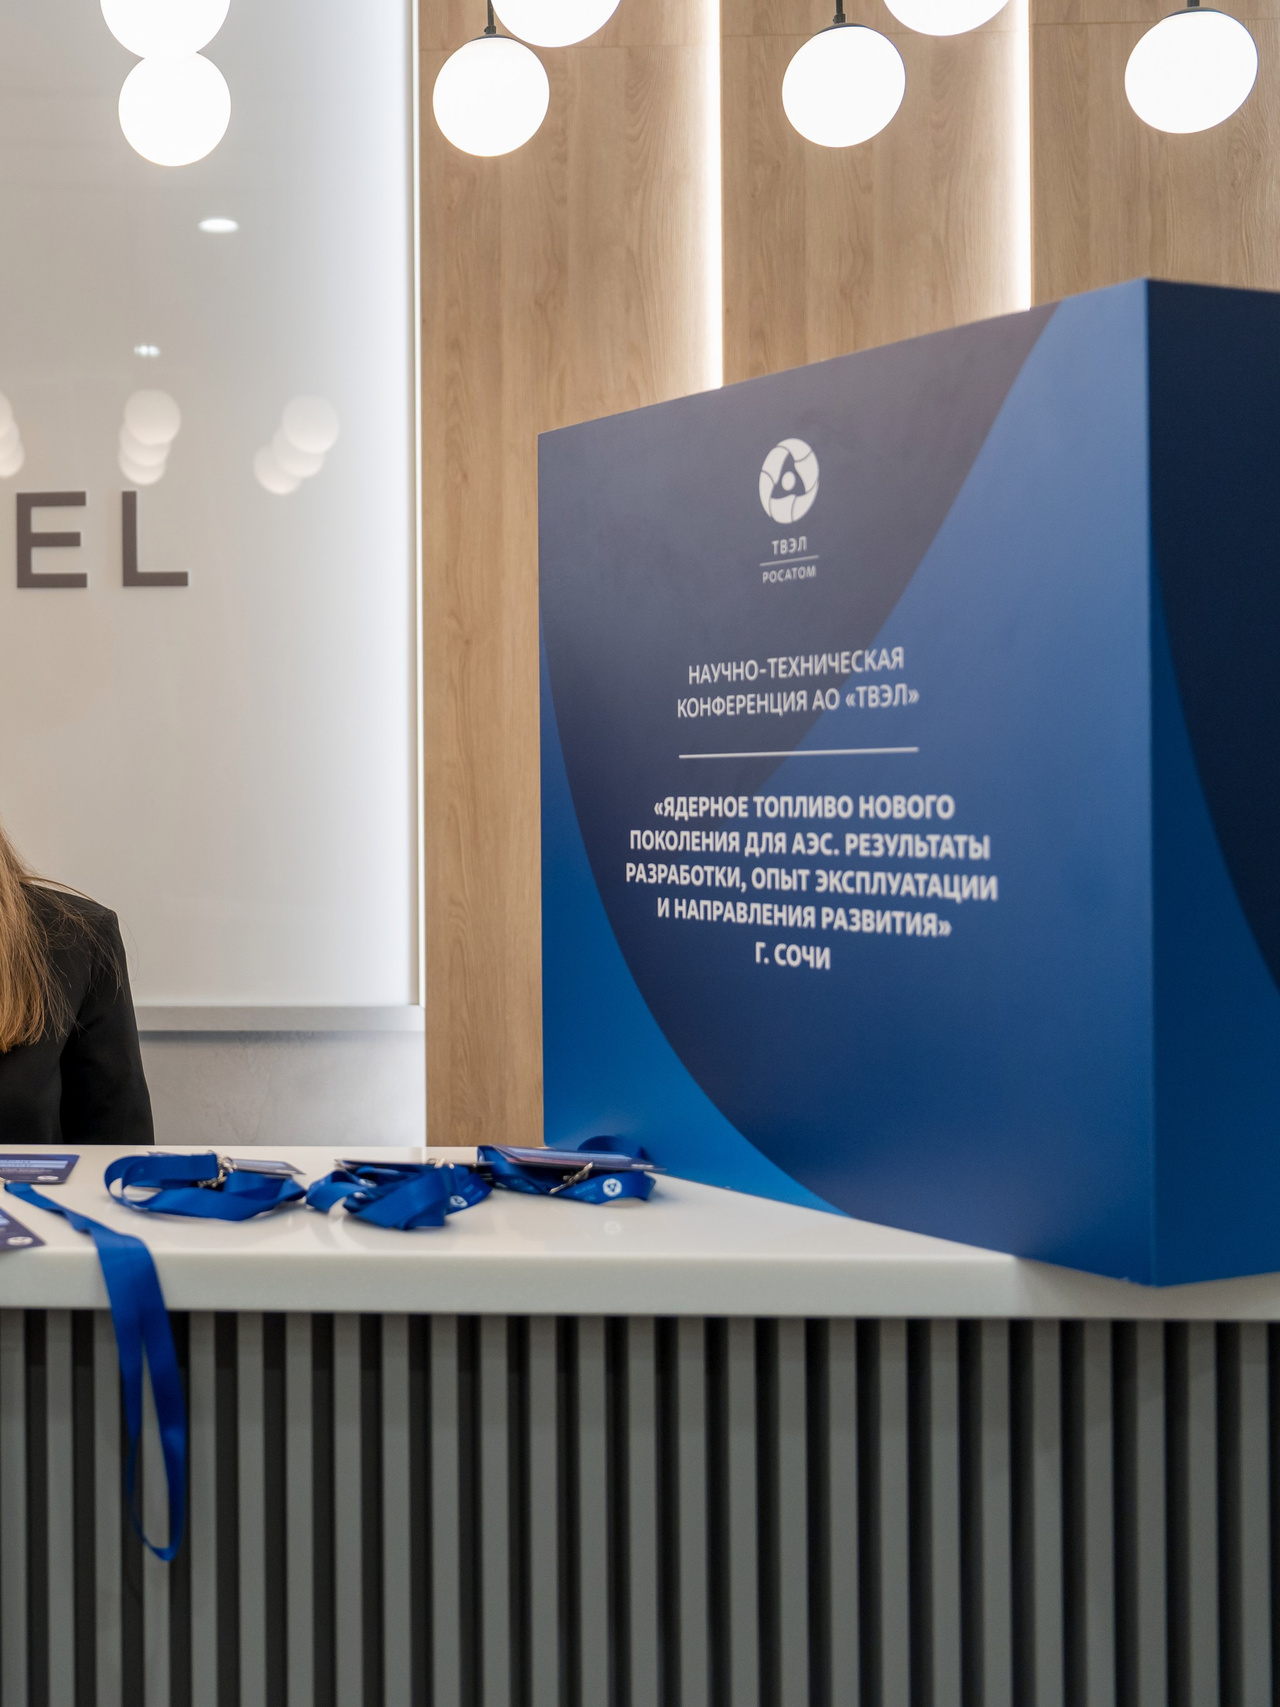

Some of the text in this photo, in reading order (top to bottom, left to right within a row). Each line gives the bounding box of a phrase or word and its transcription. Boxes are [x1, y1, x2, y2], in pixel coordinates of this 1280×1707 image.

[771, 536, 808, 555] ТВЭЛ
[761, 563, 817, 584] РОСАТОМ
[688, 646, 905, 685] НАУЧНО-ТЕХНИЧЕСКАЯ
[676, 682, 920, 718] КОНФЕРЕНЦИЯ АО «ТВЭЛ»
[653, 794, 956, 822] «ЯДЕРНОЕ ТОПЛИВО НОВОГО
[629, 829, 991, 860] ПОКОЛЕНИЯ ДЛЯ АЭС. РЕЗУЛЬТАТЫ
[625, 861, 999, 904] РАЗРАБОТКИ, ОПЫТ ЭКСПЛУАТАЦИИ
[657, 897, 952, 938] И НАПРАВЛЕНИЯ РАЗВИТИЯ»
[755, 941, 831, 970] Г. СОЧИ
